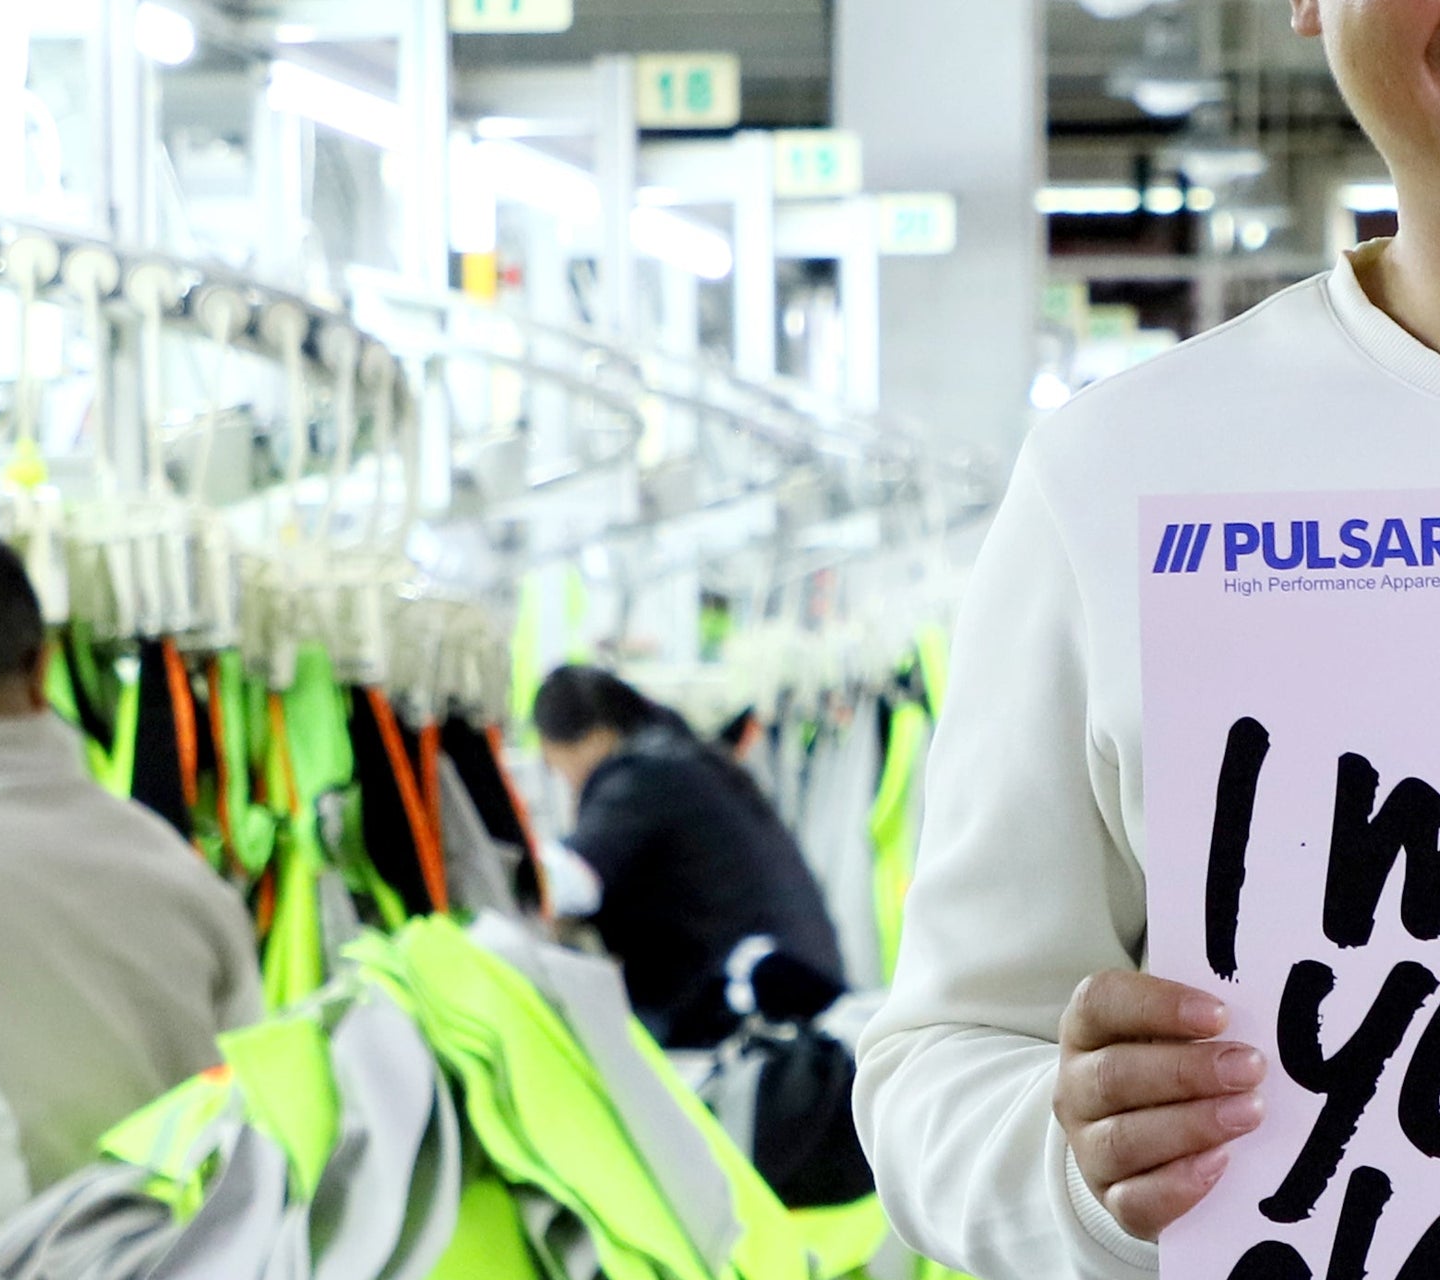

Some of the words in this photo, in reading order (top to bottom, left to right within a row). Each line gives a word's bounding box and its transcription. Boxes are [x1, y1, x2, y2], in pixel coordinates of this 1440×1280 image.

[1223, 577, 1262, 596] High
[1268, 575, 1376, 593] Performance
[1204, 716, 1271, 983] I
